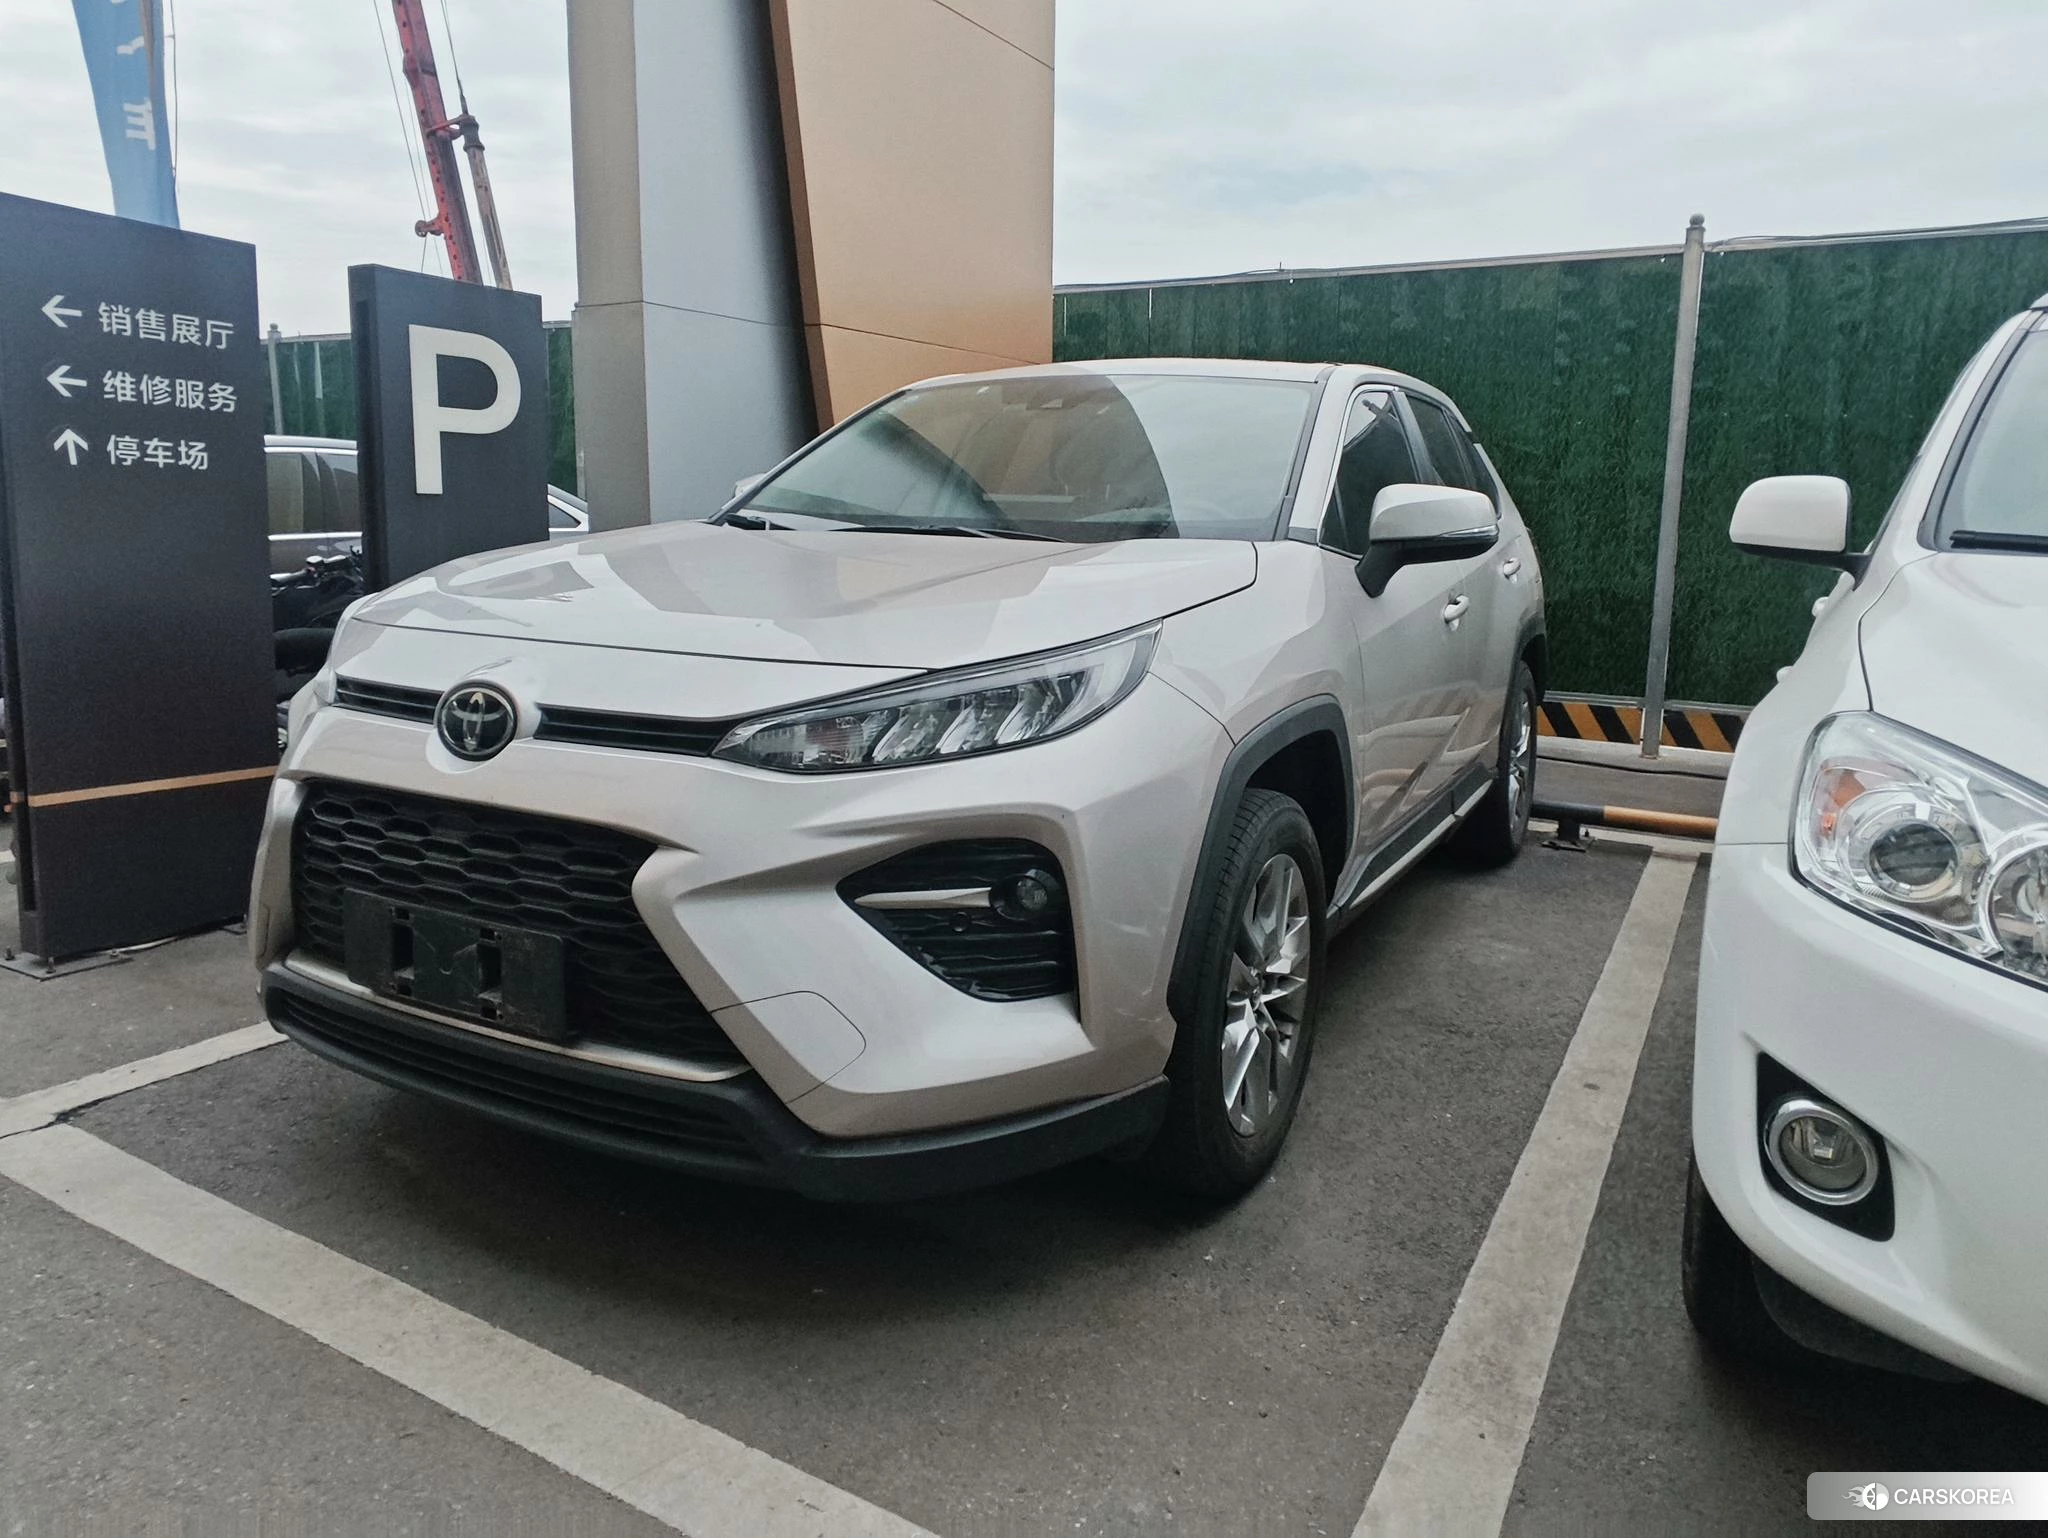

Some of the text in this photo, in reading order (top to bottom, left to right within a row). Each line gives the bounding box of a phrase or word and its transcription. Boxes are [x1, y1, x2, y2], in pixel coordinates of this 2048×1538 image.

[98, 302, 235, 350] 销售展厅
[102, 369, 237, 413] 维修服务
[408, 323, 522, 495] P
[106, 434, 209, 470] 停车场
